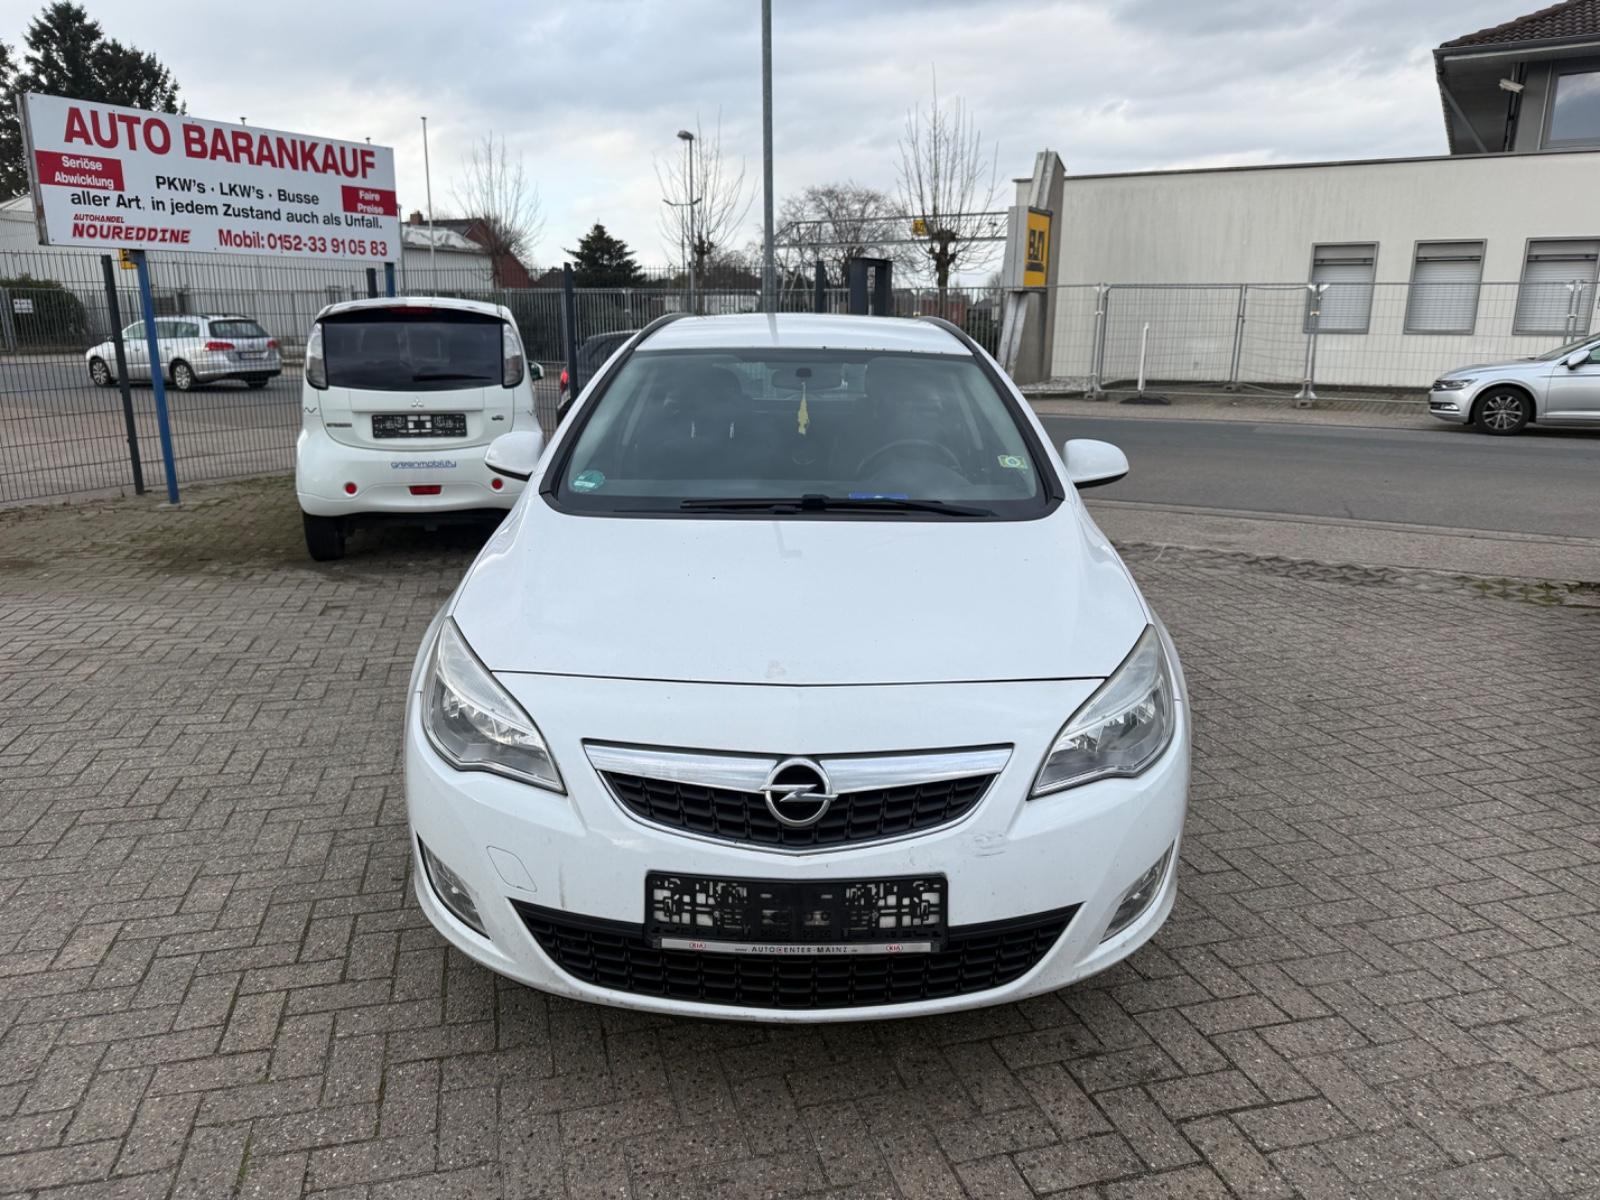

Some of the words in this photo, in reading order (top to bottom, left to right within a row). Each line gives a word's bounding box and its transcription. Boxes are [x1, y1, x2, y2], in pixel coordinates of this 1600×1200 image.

[64, 107, 171, 155] AUTO
[182, 123, 375, 179] BARANKAUF
[61, 155, 102, 171] Seriöse
[54, 171, 114, 189] Abwicklung
[155, 175, 206, 194] PKW's
[219, 182, 264, 200] LKW's
[277, 188, 320, 205] Busse
[359, 190, 380, 201] Faire
[70, 190, 110, 207] aller
[151, 196, 165, 212] in
[170, 197, 218, 215] jedem
[222, 203, 281, 221] Zustand
[286, 211, 319, 224] auch
[323, 213, 341, 226] als
[344, 214, 382, 229] Unfall.
[357, 202, 384, 215] Preise
[73, 213, 125, 224] AUTOHANDEL
[72, 223, 191, 243] NOUREDDINE
